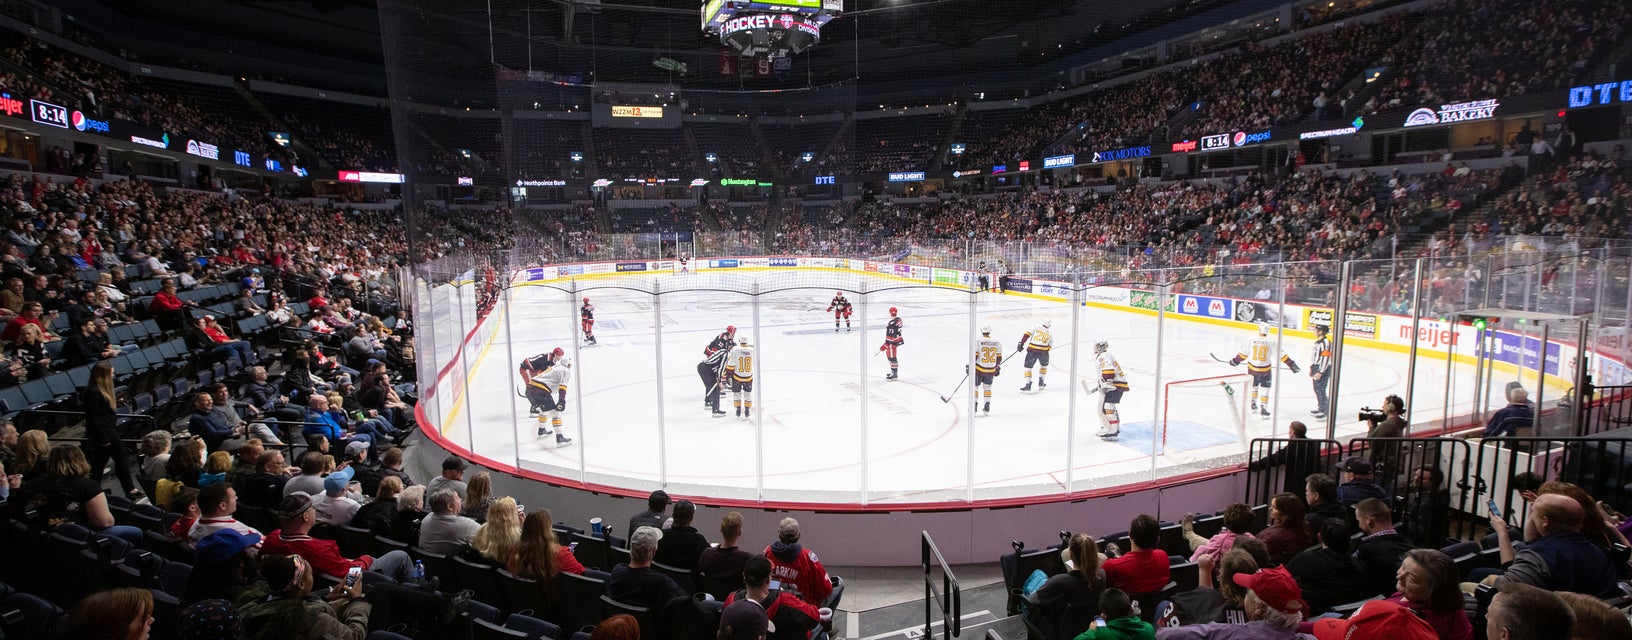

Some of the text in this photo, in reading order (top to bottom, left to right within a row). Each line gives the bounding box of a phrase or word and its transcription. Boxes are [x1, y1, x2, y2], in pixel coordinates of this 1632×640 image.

[725, 14, 776, 35] HOCKEY
[0, 92, 24, 116] eijer
[39, 104, 66, 123] 8:14
[1440, 107, 1497, 123] BAKERY
[86, 118, 110, 132] pepsi
[1207, 136, 1228, 147] 8:14
[1246, 130, 1271, 143] pepsi
[1172, 139, 1196, 152] meijer
[234, 150, 251, 167] DTE
[1100, 146, 1151, 161] FOX MOTORS
[1056, 157, 1073, 165] LIGHT
[728, 178, 756, 186] Huntington
[815, 176, 835, 185] DTE
[1310, 311, 1331, 320] Auto
[1344, 314, 1376, 323] UMPER
[1344, 323, 1375, 333] UMPER
[1400, 322, 1460, 347] meijer
[981, 347, 997, 363] 32
[1252, 345, 1269, 362] 10
[738, 356, 752, 373] 18
[774, 566, 799, 580] ARKIN
